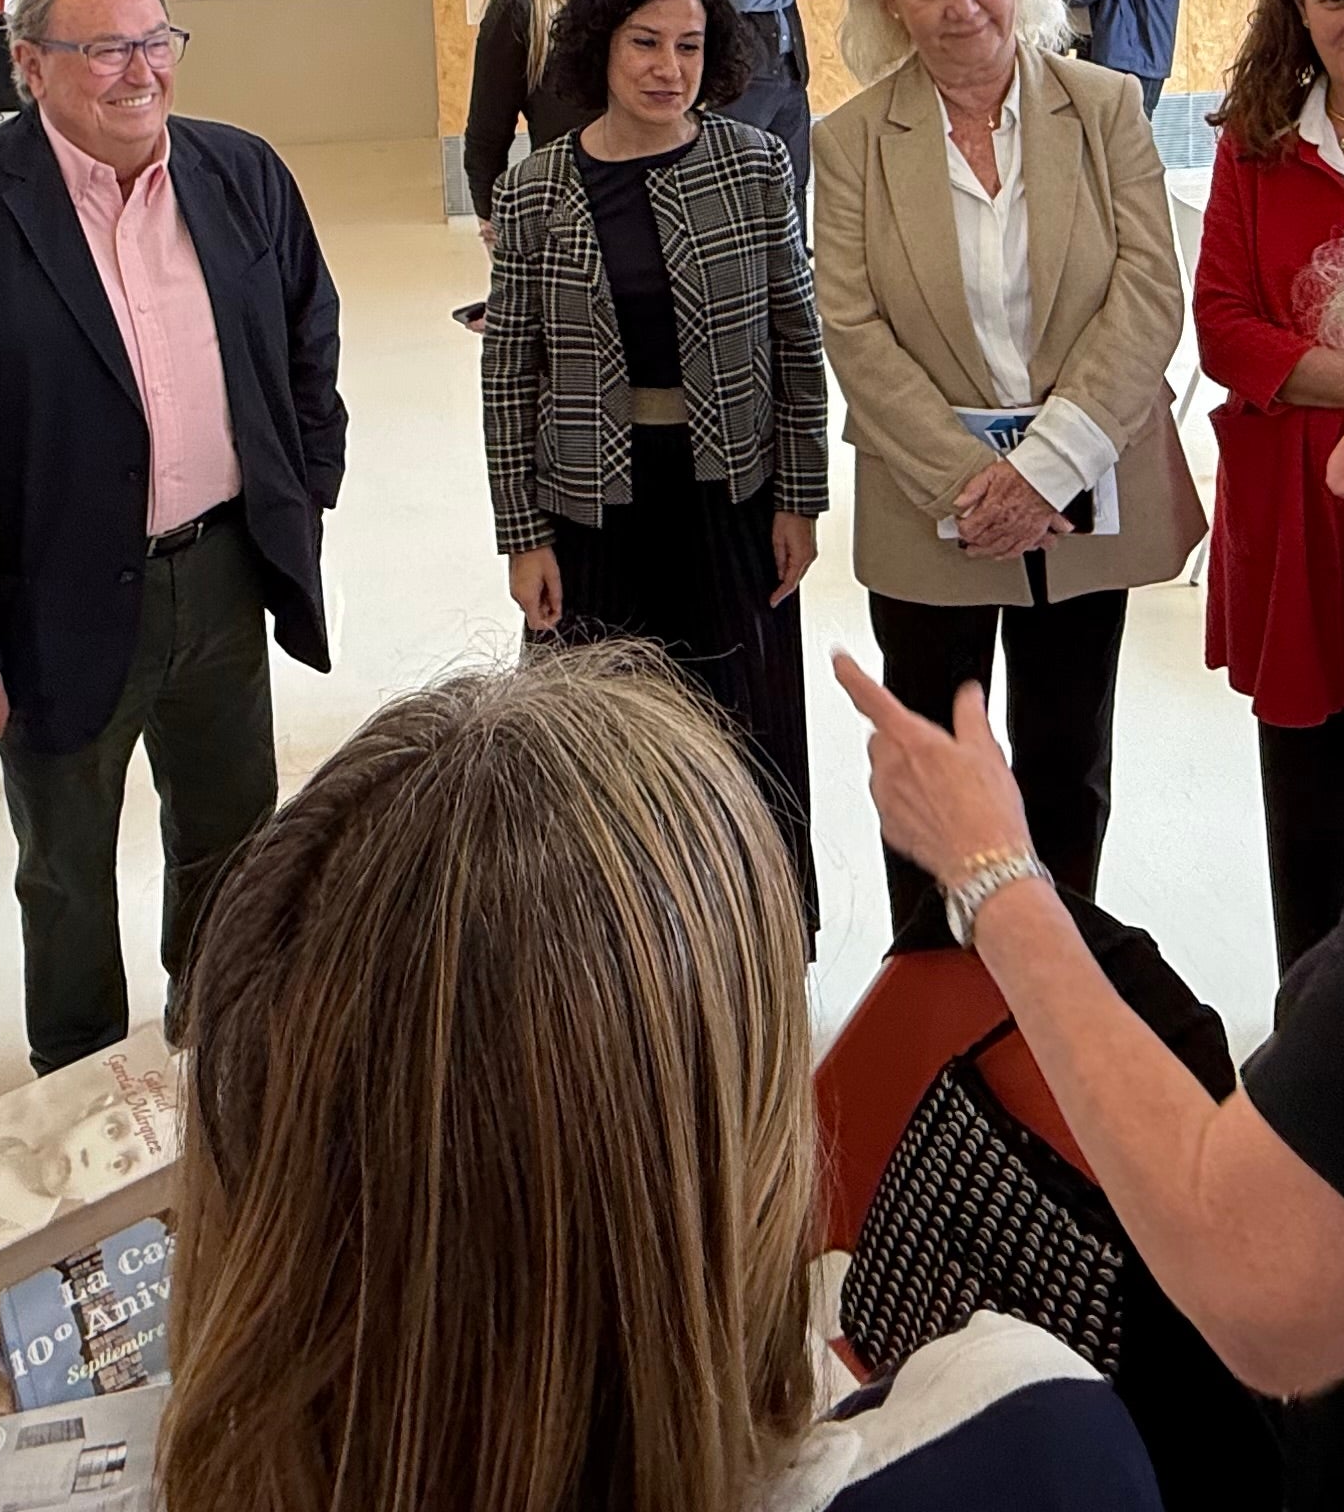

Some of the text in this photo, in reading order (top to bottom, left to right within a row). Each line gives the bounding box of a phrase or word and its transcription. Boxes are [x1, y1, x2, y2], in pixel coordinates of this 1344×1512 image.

[137, 1070, 178, 1113] Gabriel
[59, 1269, 111, 1308] La
[66, 1322, 166, 1385] Septiembre
